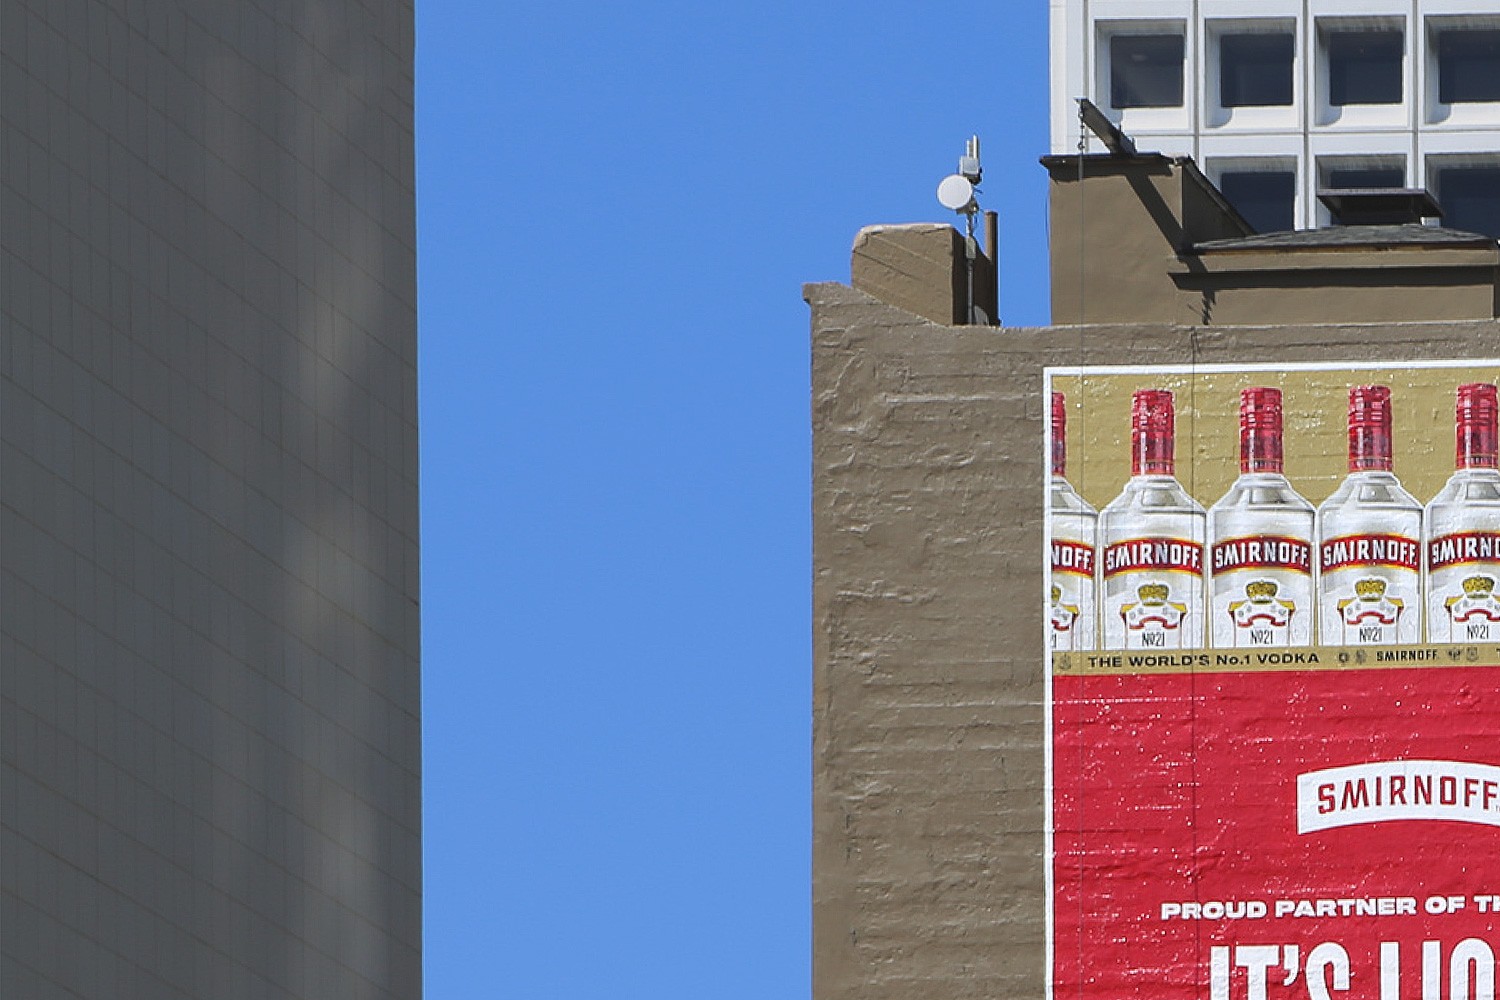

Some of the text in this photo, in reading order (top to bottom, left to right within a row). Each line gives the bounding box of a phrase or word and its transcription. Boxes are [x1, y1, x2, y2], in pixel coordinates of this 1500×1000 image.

[1088, 656, 1122, 668] THE
[1128, 655, 1209, 667] WORLD'S
[1216, 653, 1250, 666] No.1
[1257, 652, 1320, 665] VODKA
[1161, 900, 1267, 920] PROUD
[1275, 896, 1417, 918] PARTNER
[1424, 895, 1466, 914] OF
